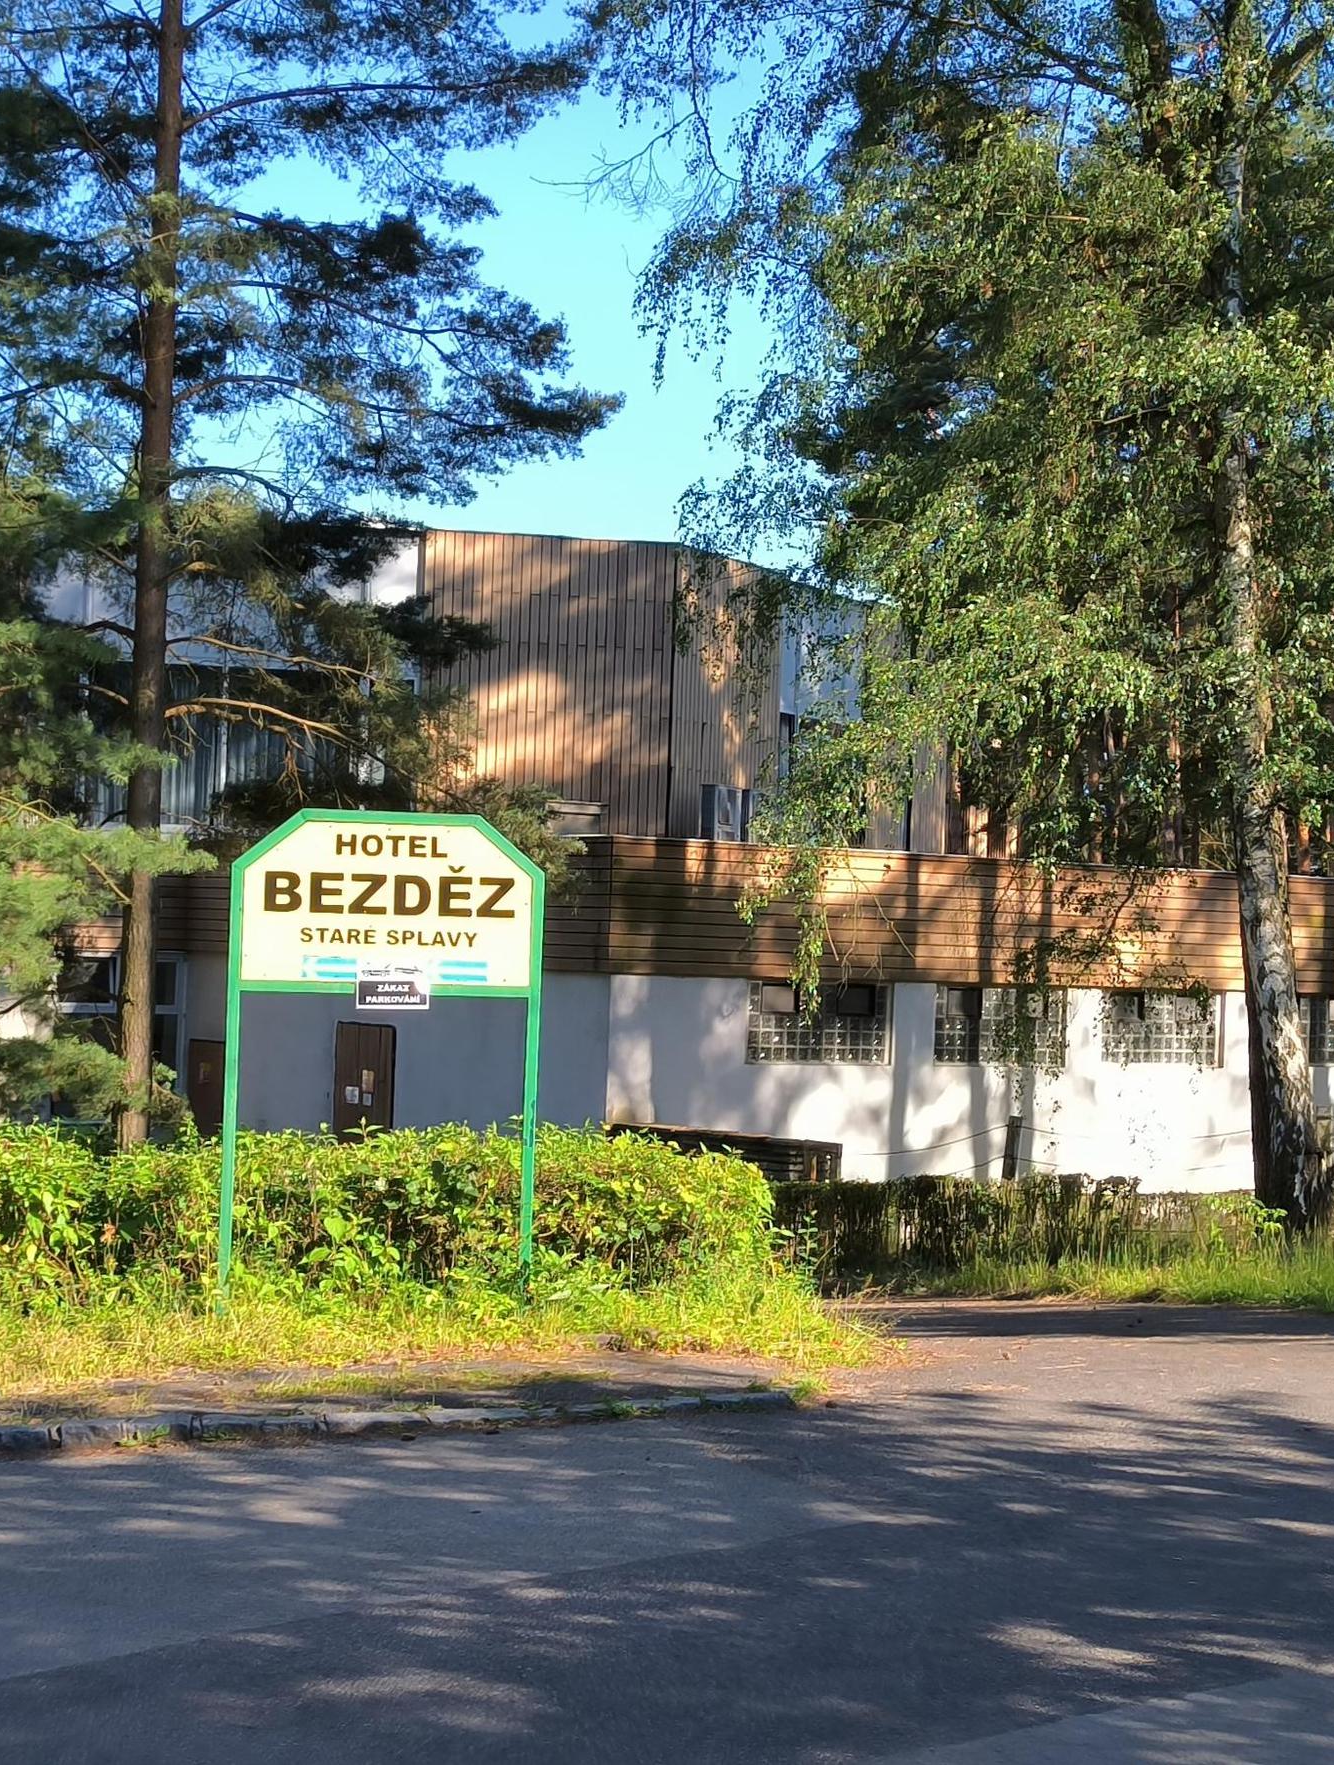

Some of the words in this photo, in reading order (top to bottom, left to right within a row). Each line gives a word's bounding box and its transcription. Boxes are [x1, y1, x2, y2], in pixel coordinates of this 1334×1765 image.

[335, 834, 448, 858] HOTEL
[263, 866, 516, 918] BEZDĚZ
[386, 929, 478, 947] SPLAVY
[376, 983, 410, 993] ZÁKAZ
[365, 995, 420, 1004] PARKOVÁNÍ
